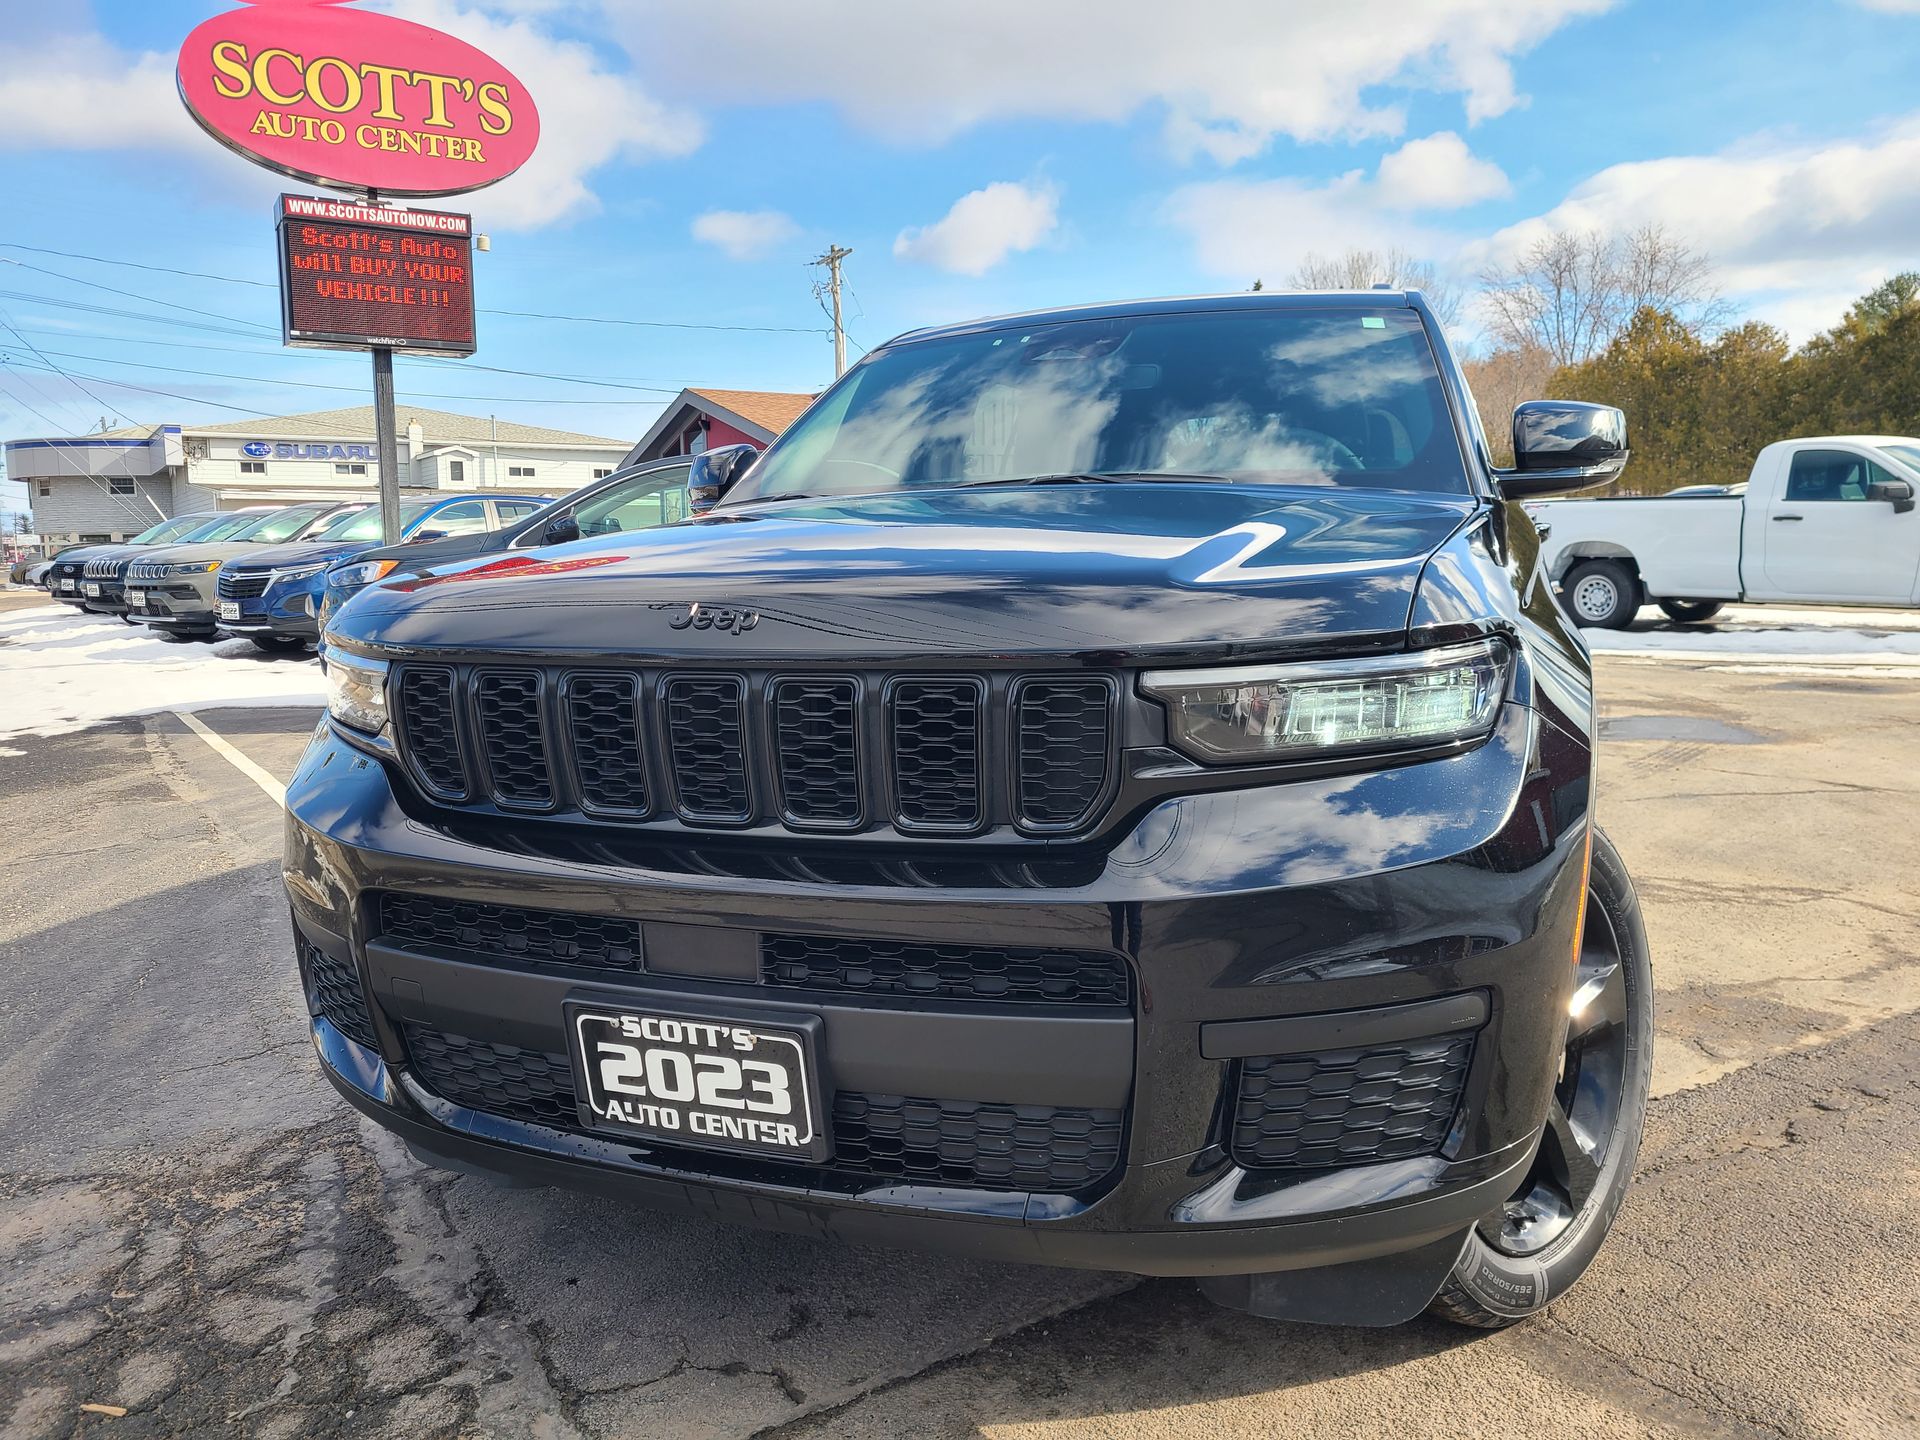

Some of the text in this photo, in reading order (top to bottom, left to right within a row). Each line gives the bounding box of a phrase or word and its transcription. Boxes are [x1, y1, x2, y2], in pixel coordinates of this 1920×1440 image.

[211, 40, 513, 135] SCOTT'S
[250, 111, 487, 163] AUTO CENTER
[288, 199, 466, 232] WWW.SCOTTSAUTONOW.COM
[302, 227, 457, 260] Scott's Auto
[294, 253, 464, 283] will BUY YOUR
[316, 279, 449, 307] VEHICLE!!!
[668, 602, 759, 636] Jeep
[620, 1015, 754, 1051] SCOTT'S
[597, 1042, 792, 1115] 2023
[605, 1100, 799, 1147] AUTO CENTER
[1482, 1266, 1532, 1294] 265/50R20
